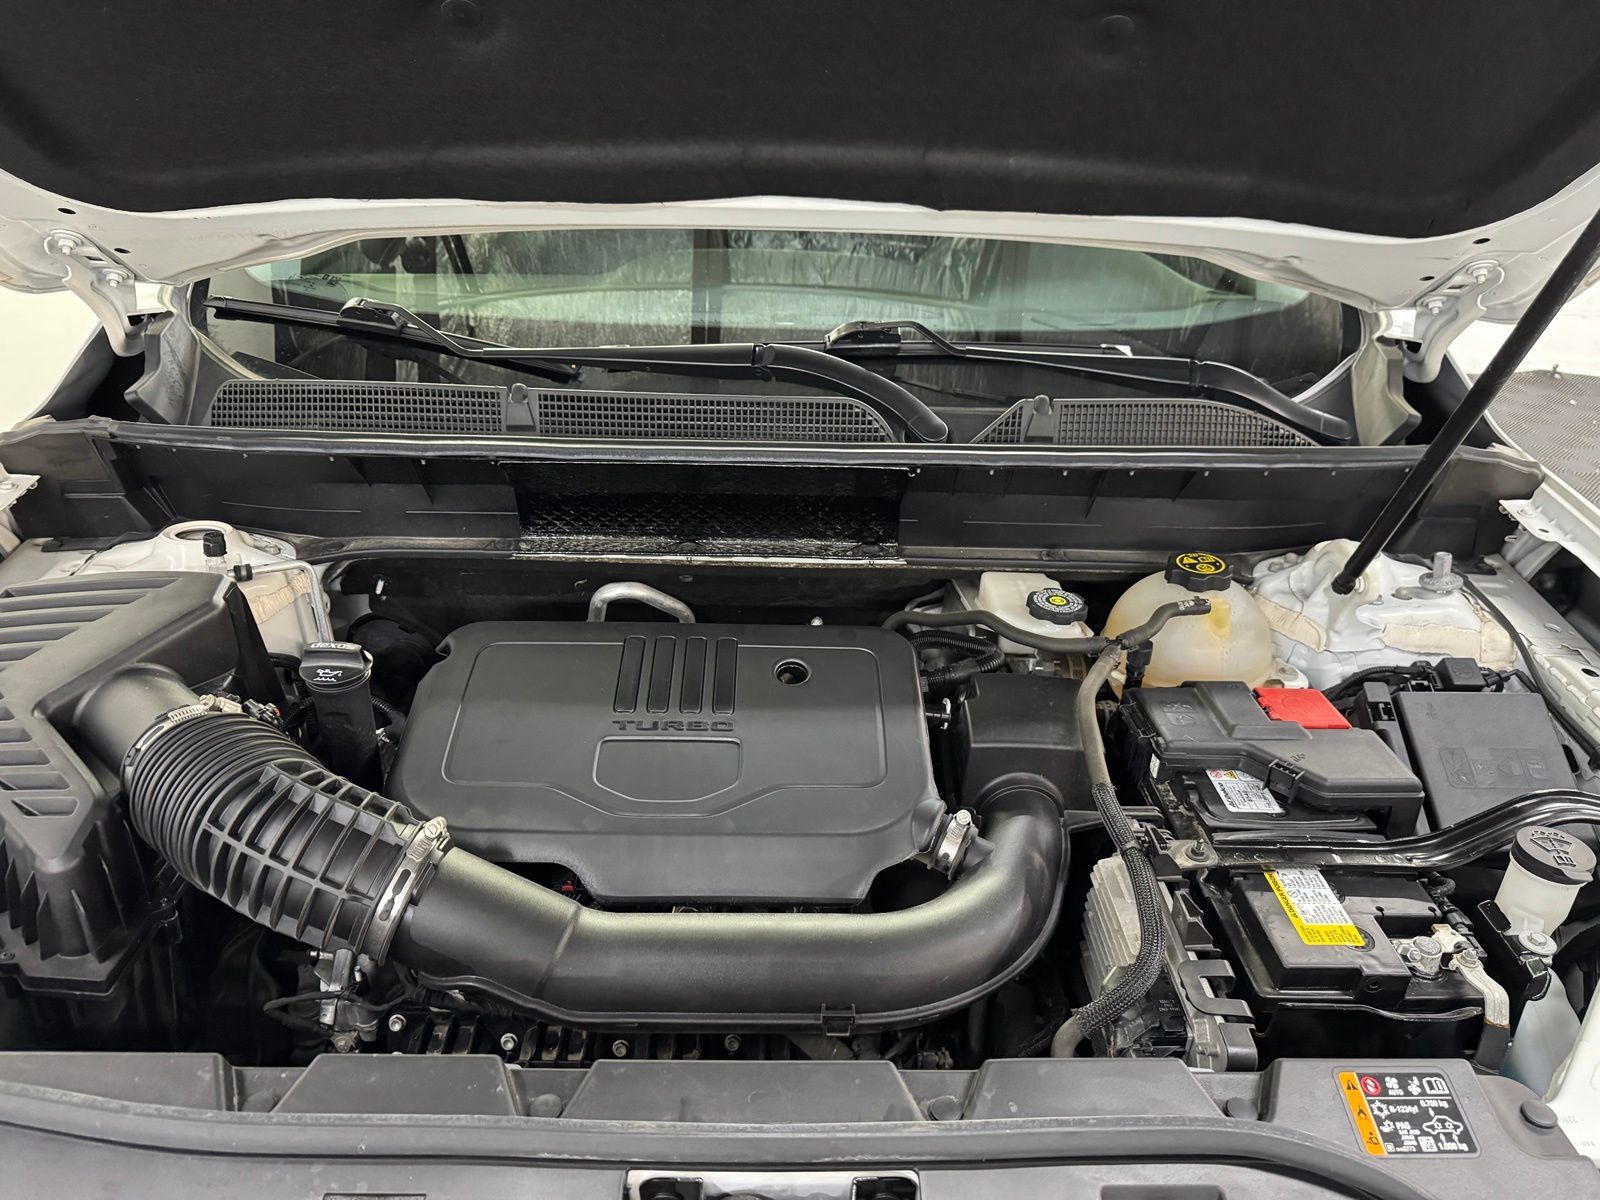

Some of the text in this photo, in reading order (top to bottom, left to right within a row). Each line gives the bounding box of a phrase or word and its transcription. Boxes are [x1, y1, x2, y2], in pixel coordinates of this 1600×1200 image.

[612, 720, 734, 731] TURBO
[1267, 873, 1295, 914] DANGER POISON
[1438, 1100, 1449, 1108] kg
[1458, 1142, 1469, 1152] kg
